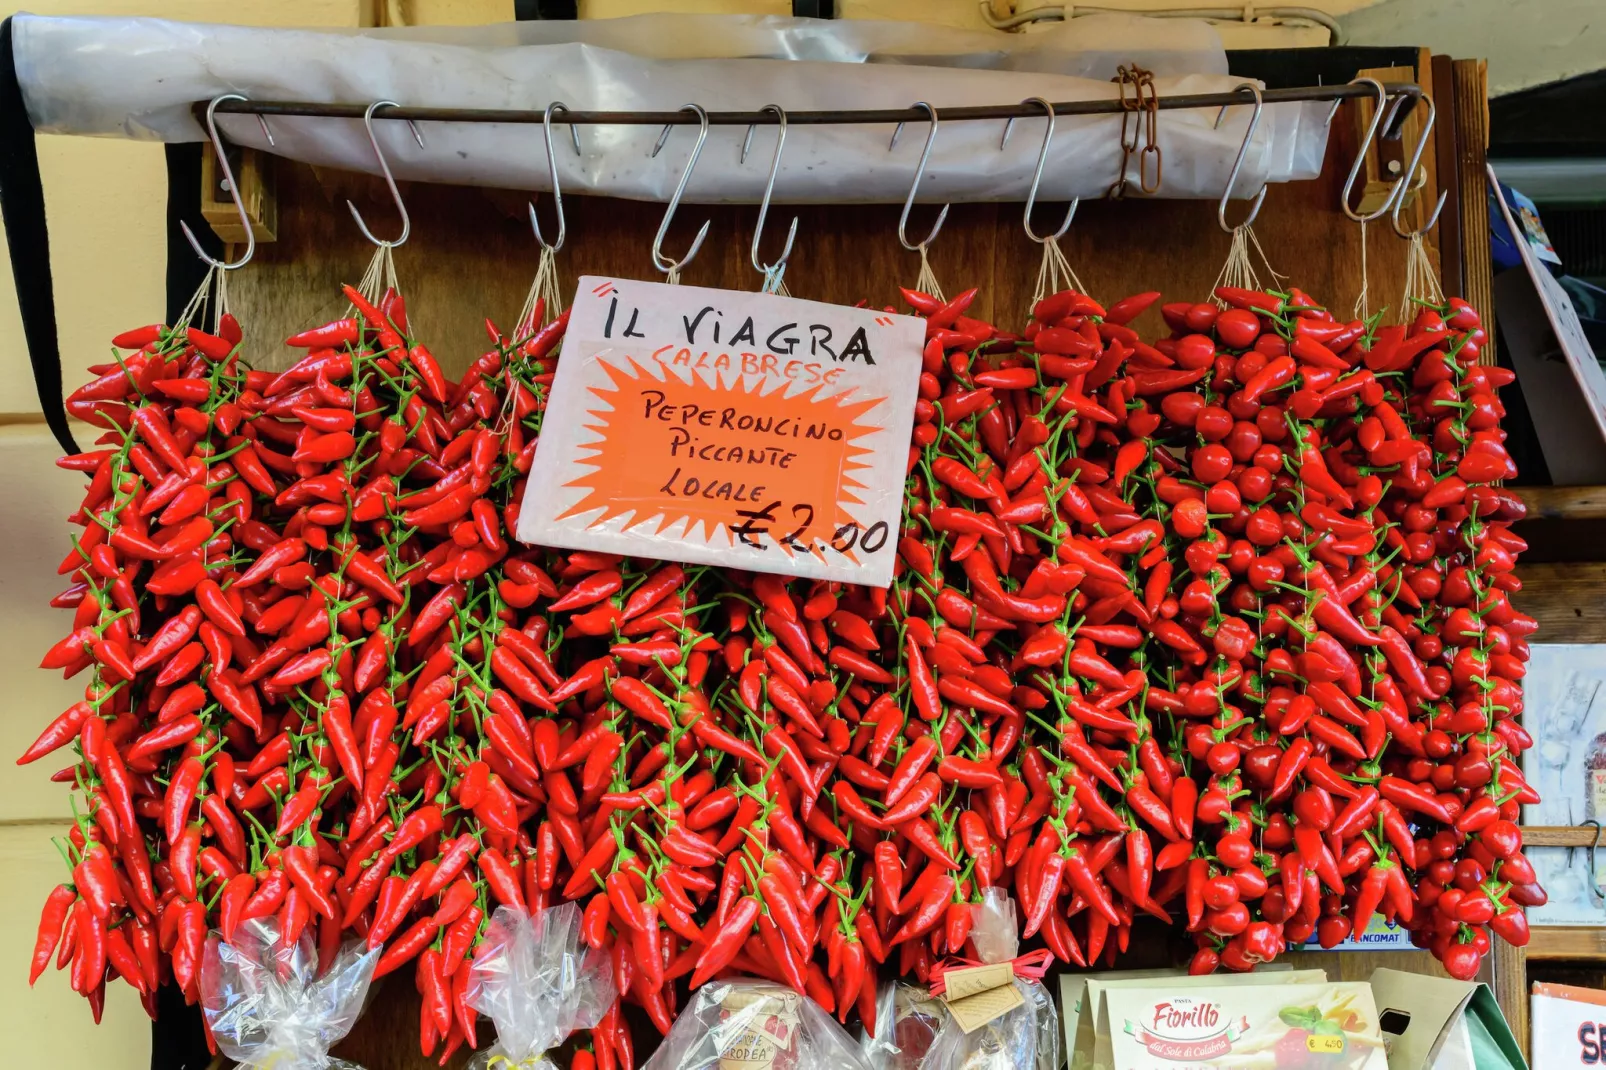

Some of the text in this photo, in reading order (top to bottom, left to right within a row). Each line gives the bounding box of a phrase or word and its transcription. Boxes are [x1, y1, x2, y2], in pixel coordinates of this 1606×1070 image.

[651, 344, 846, 386] CALABRESE
[641, 390, 844, 442] PEPERONCINO
[668, 427, 798, 469] PICCANTE
[660, 468, 767, 503] LOCALE
[728, 500, 890, 554] €2.00
[1350, 933, 1400, 943] BNCOMAT
[1153, 1002, 1219, 1031] Fiorillo
[1149, 1039, 1227, 1057] dal Sole di Calabria
